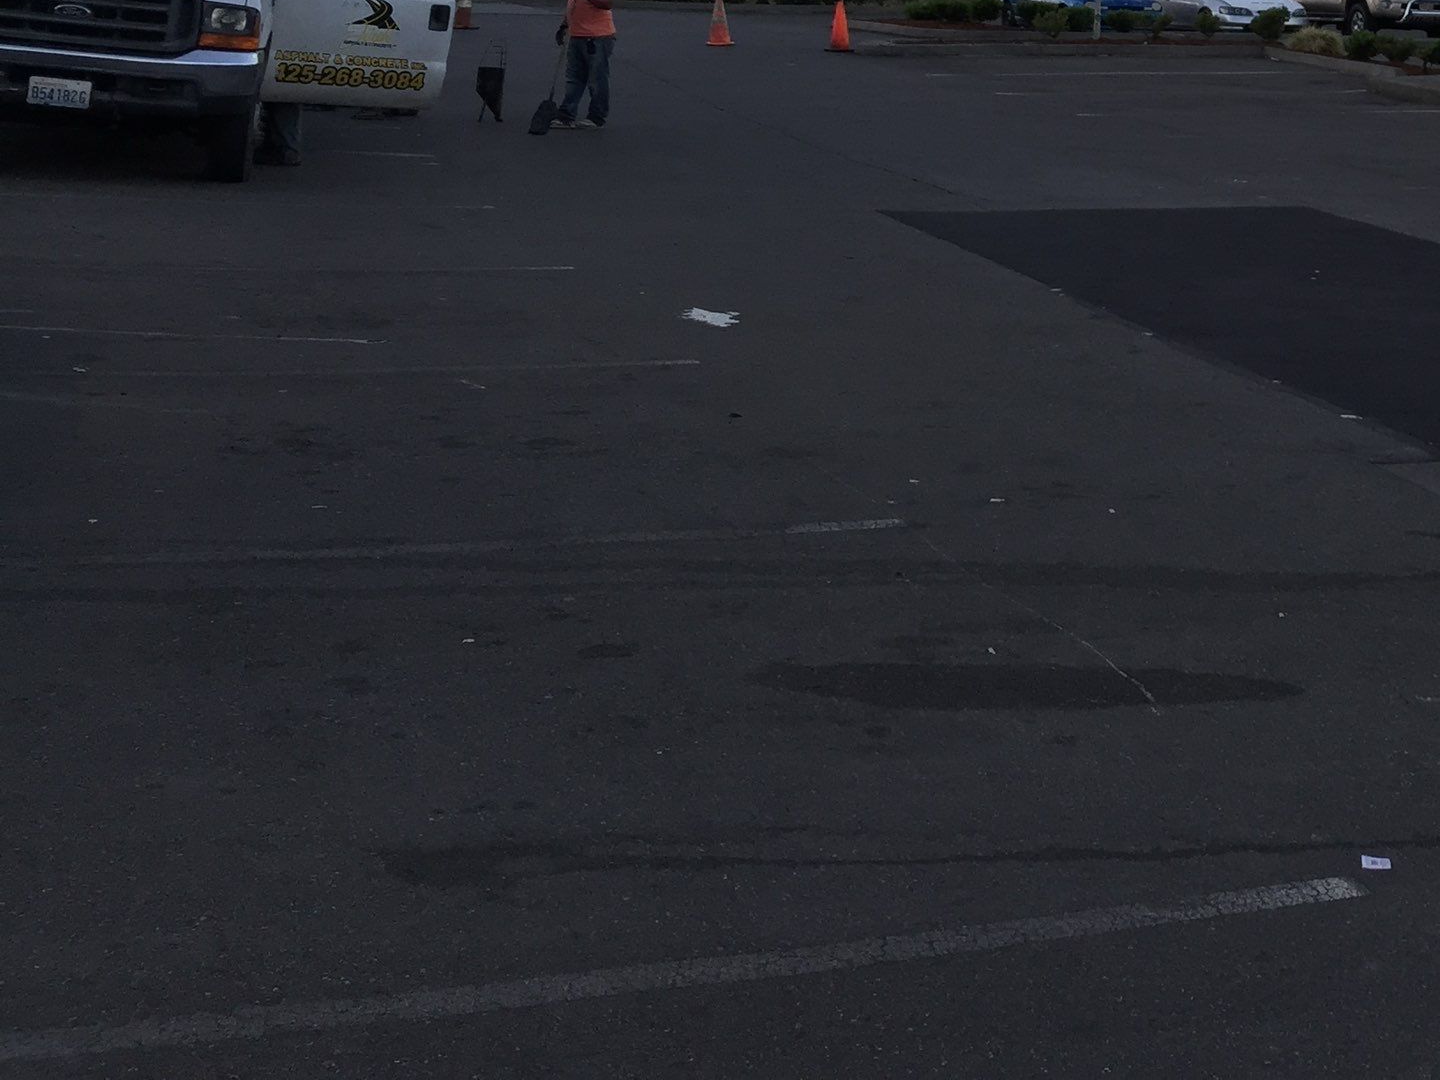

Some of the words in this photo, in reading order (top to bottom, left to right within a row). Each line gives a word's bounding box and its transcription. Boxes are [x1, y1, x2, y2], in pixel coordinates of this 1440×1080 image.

[274, 50, 331, 63] ASPHALT
[333, 55, 343, 65] &
[347, 56, 409, 69] CONCRETE
